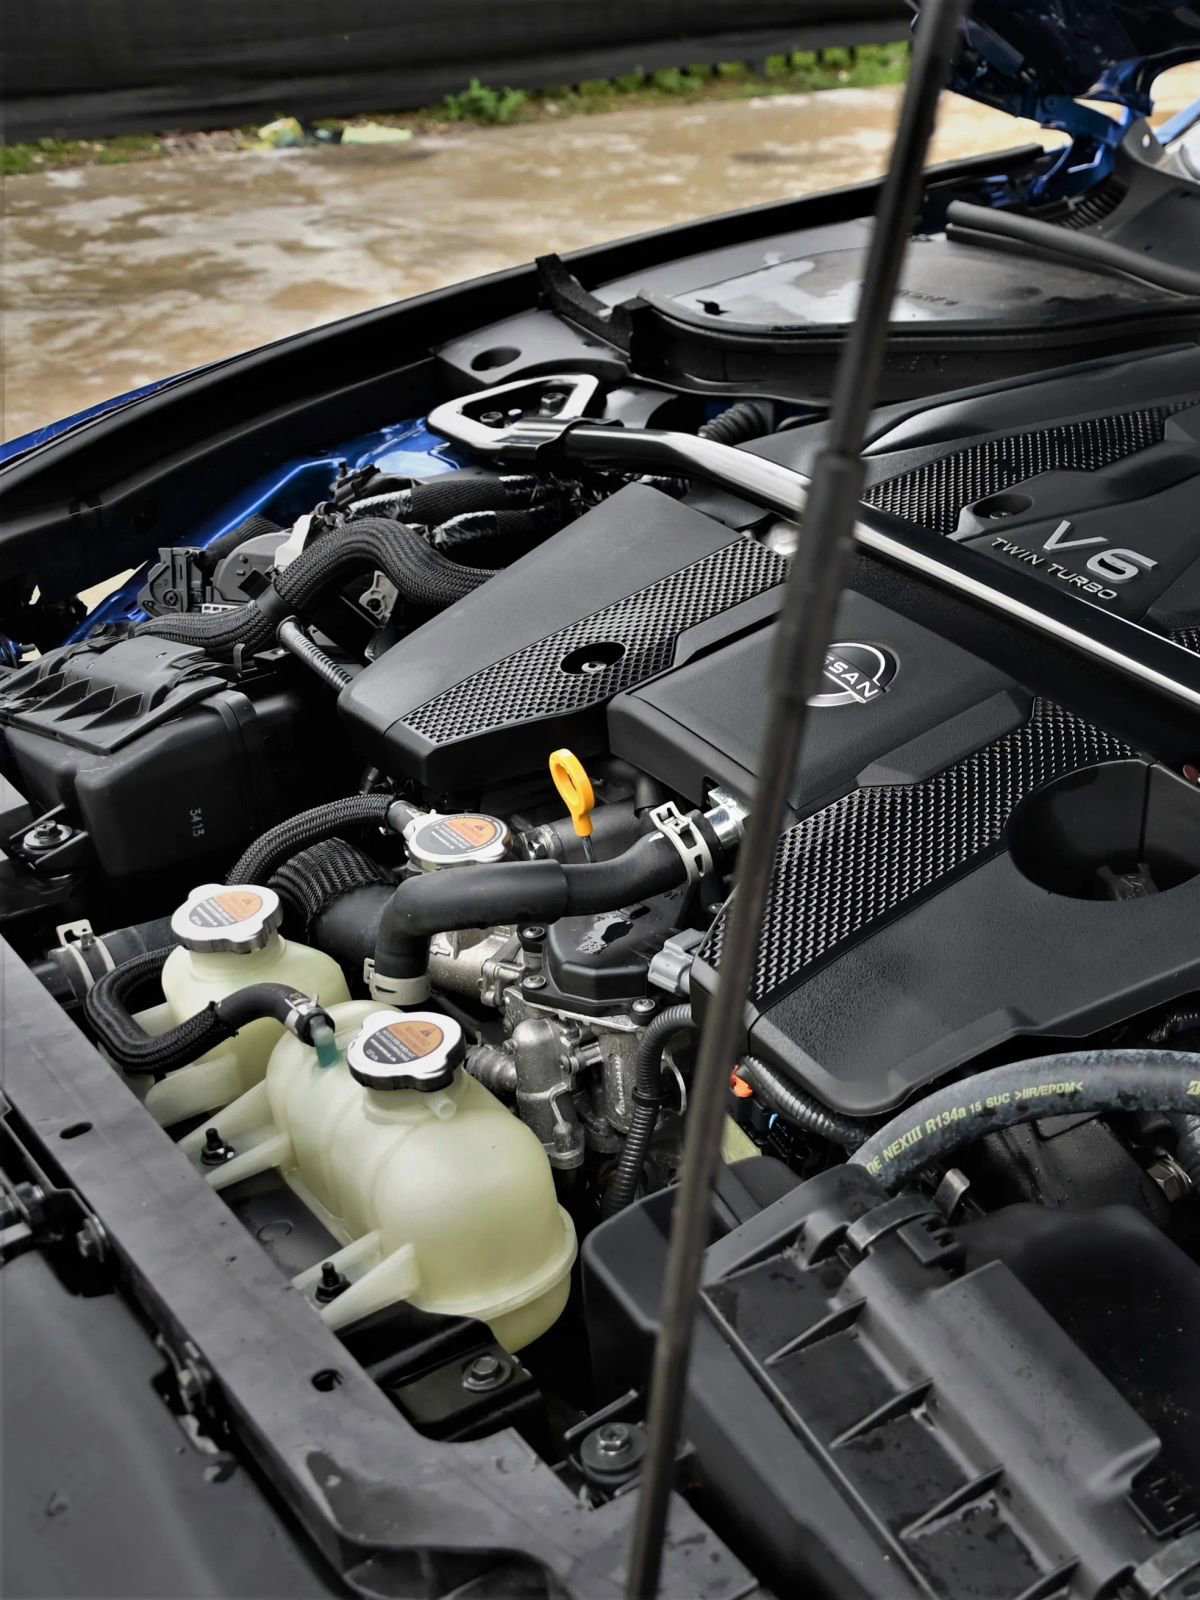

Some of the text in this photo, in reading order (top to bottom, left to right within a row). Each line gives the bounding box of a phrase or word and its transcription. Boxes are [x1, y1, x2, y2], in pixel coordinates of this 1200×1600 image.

[991, 537, 1118, 600] TWIN TURBO
[1043, 519, 1159, 581] V6
[824, 655, 879, 698] SAN
[882, 1125, 923, 1162] NEXIII
[925, 1106, 967, 1134] R134a
[968, 1101, 982, 1115] 15
[985, 1093, 1011, 1109] SUC
